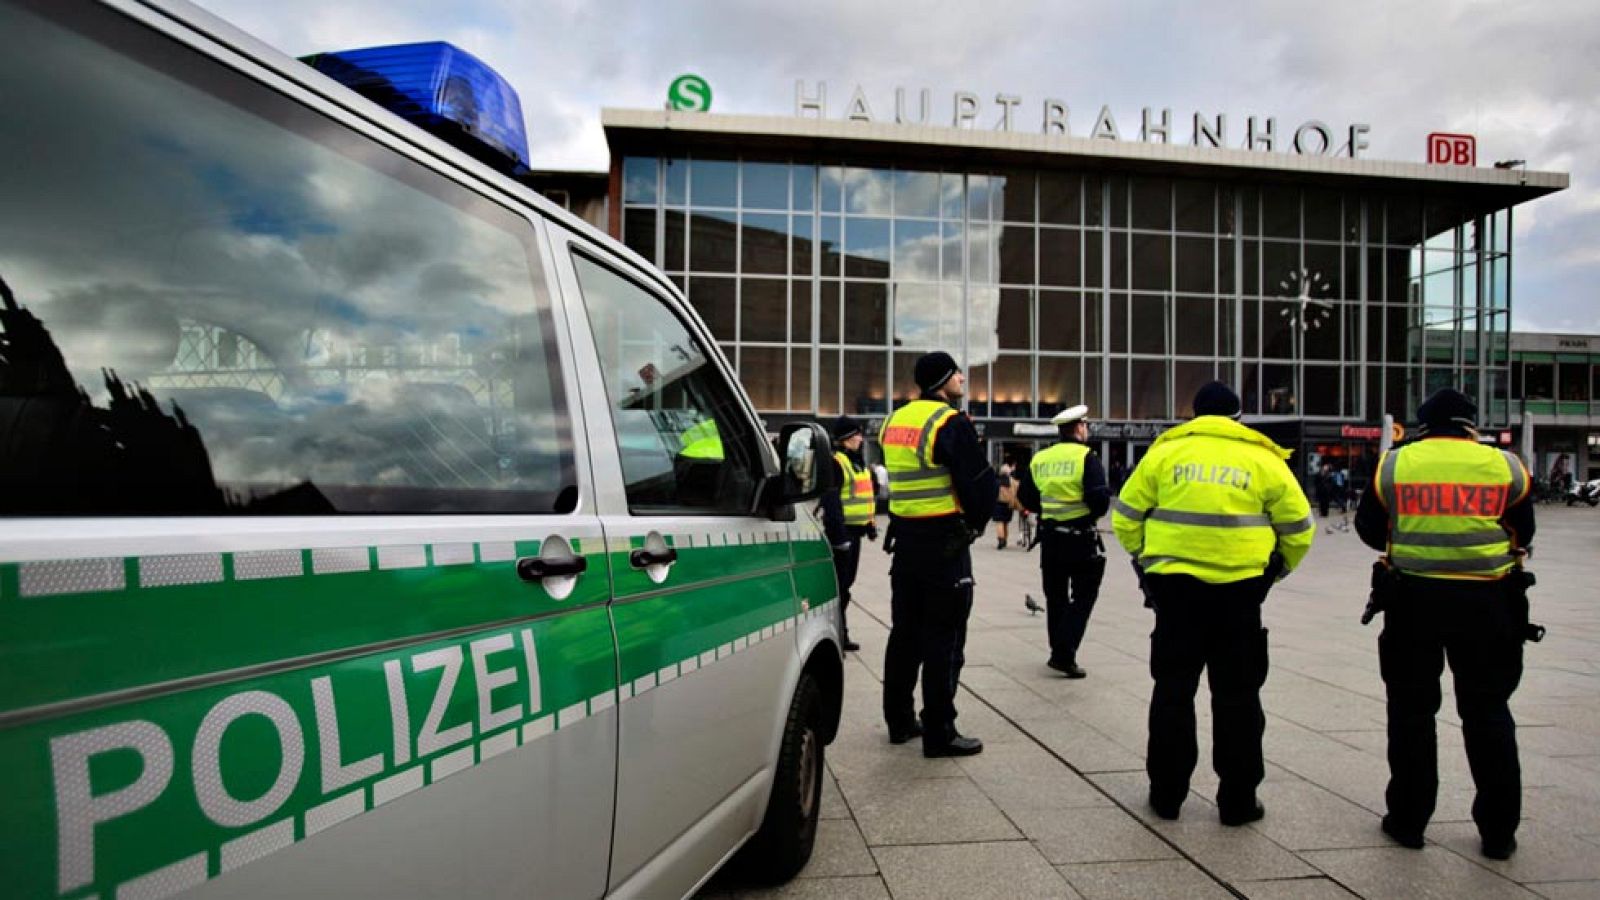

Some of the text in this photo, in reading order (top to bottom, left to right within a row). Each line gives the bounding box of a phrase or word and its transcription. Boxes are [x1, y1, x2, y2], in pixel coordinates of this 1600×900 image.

[795, 79, 1371, 158] HAUPTBAHNHOF
[1433, 137, 1471, 166] DB
[1033, 459, 1076, 478] POLIZEI
[1173, 463, 1251, 491] POLIZEI
[1401, 484, 1506, 515] POLIZEI
[49, 628, 542, 896] POLIZEI
